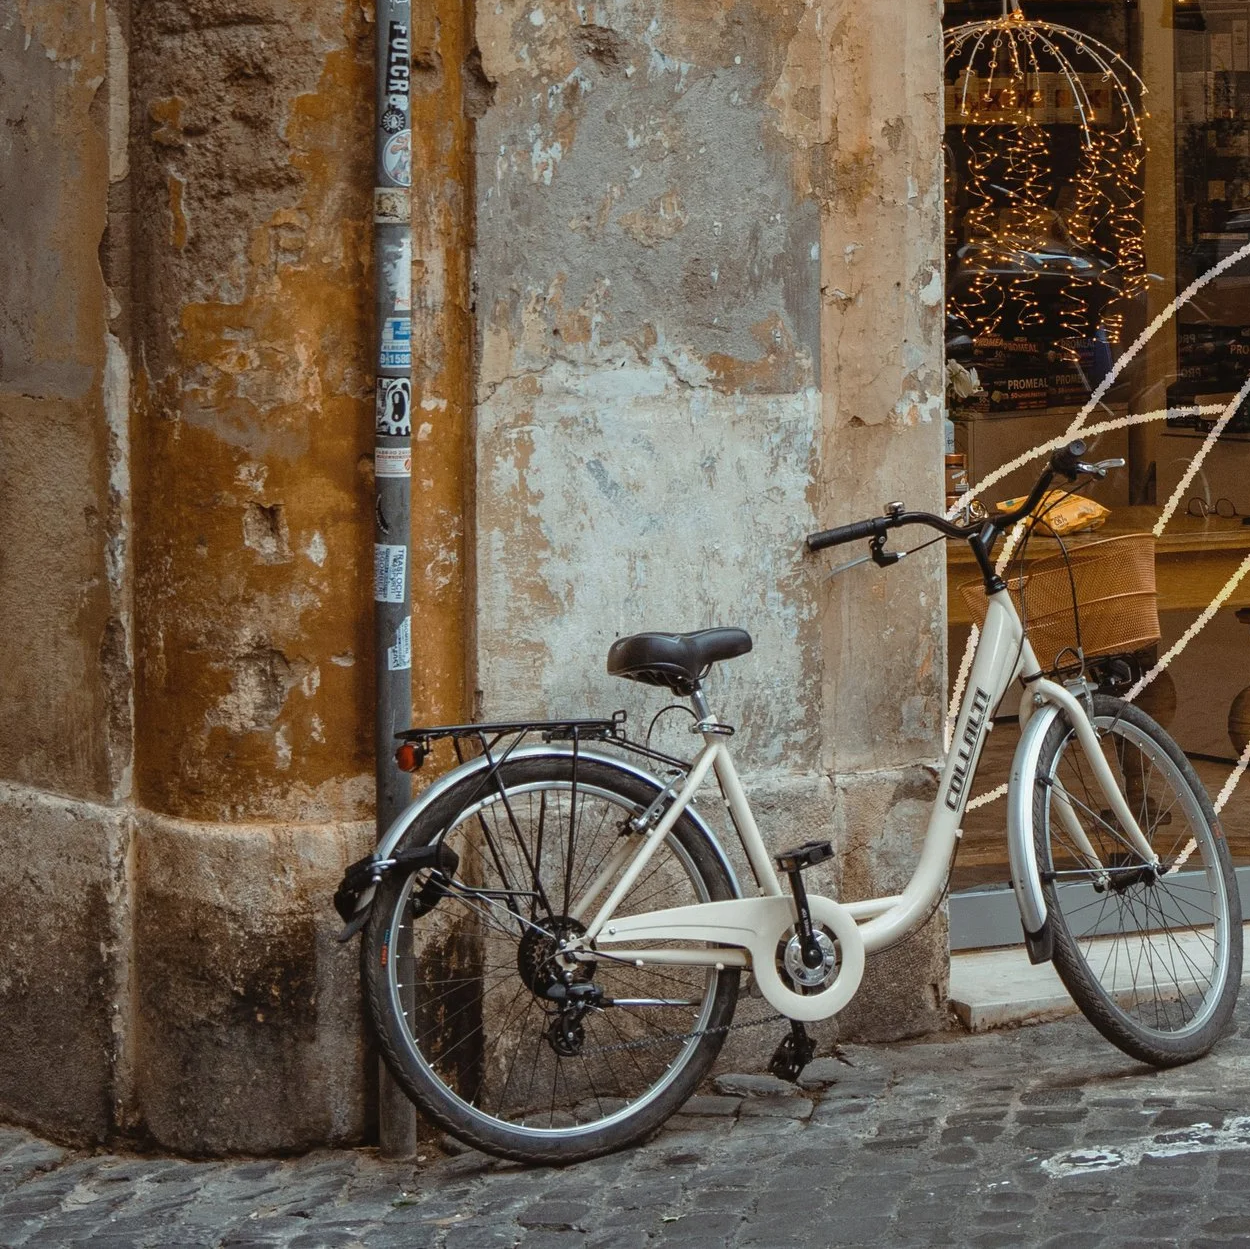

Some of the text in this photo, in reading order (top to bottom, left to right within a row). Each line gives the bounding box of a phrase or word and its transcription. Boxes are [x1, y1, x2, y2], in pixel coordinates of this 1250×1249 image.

[1007, 378, 1048, 390] PROMEAL
[395, 549, 404, 600] TRASLOCHI
[944, 686, 989, 811] COLLALTI
